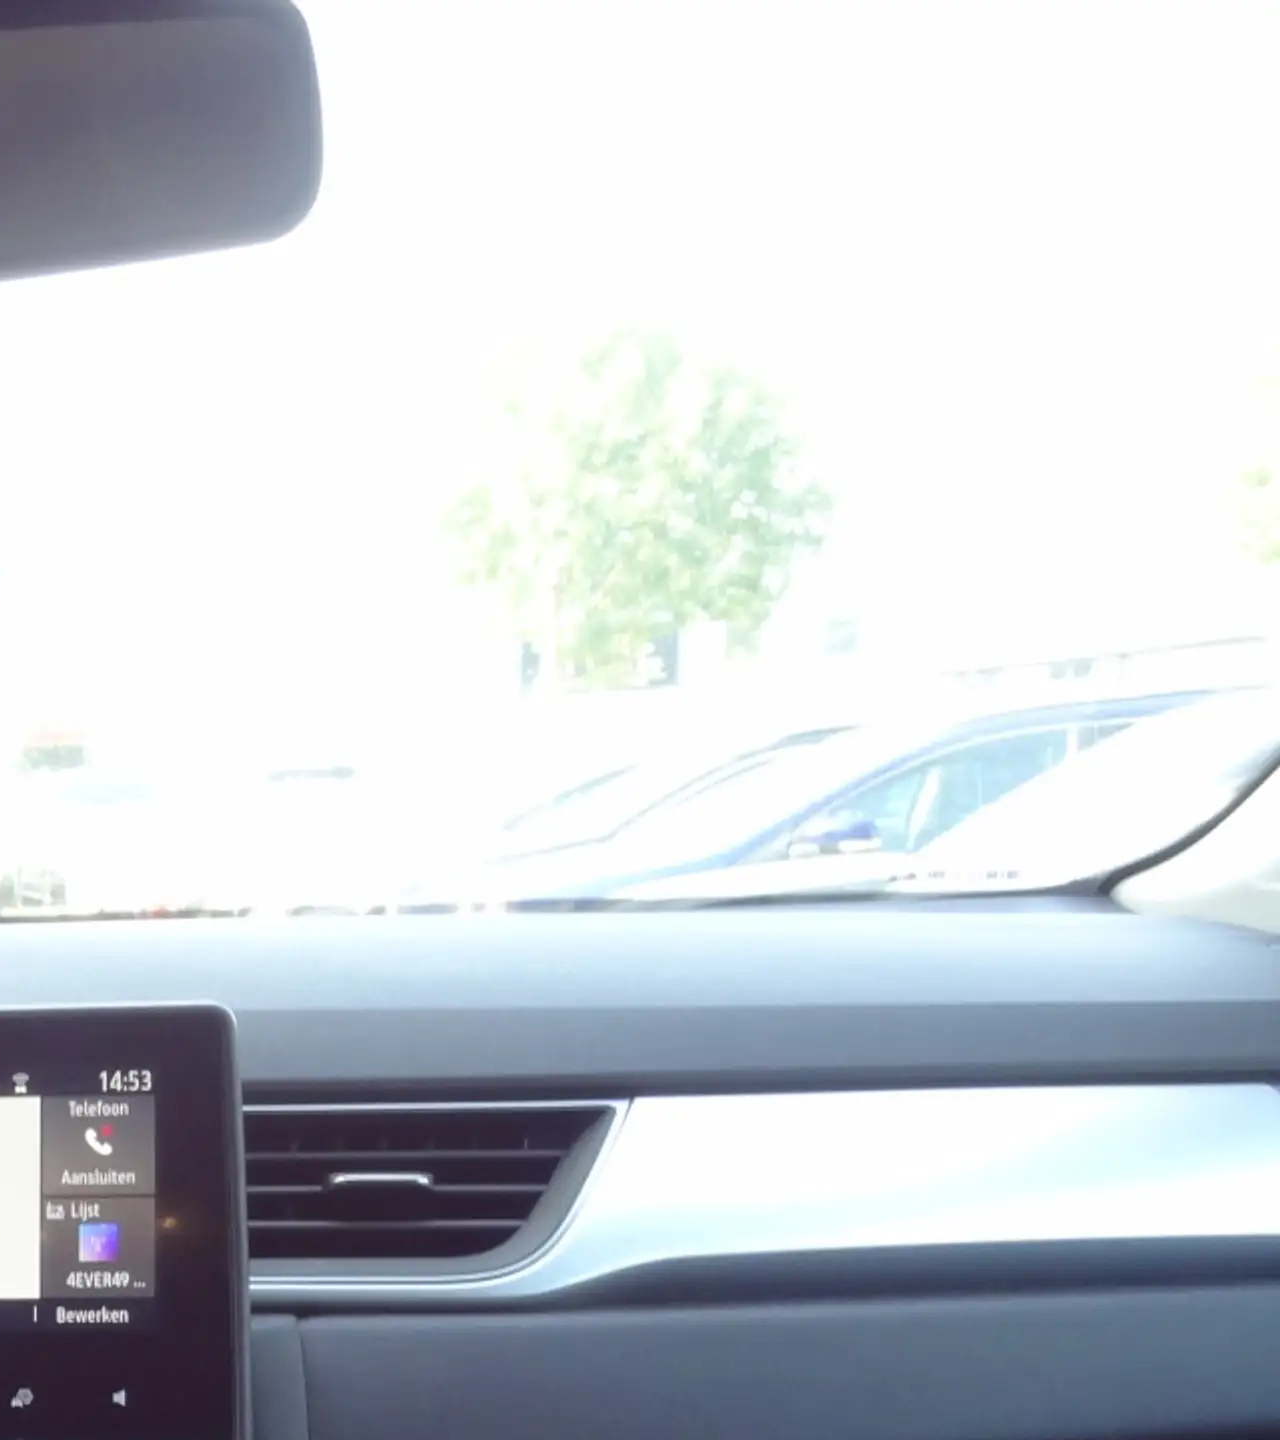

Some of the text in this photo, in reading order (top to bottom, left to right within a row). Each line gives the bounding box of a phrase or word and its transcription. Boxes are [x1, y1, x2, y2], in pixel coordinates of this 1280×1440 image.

[99, 1069, 153, 1092] 14:53
[67, 1100, 130, 1118] Telefoon
[61, 1168, 136, 1186] Aansluiten
[70, 1200, 101, 1222] Lijst
[55, 1305, 130, 1324] Bewerken
